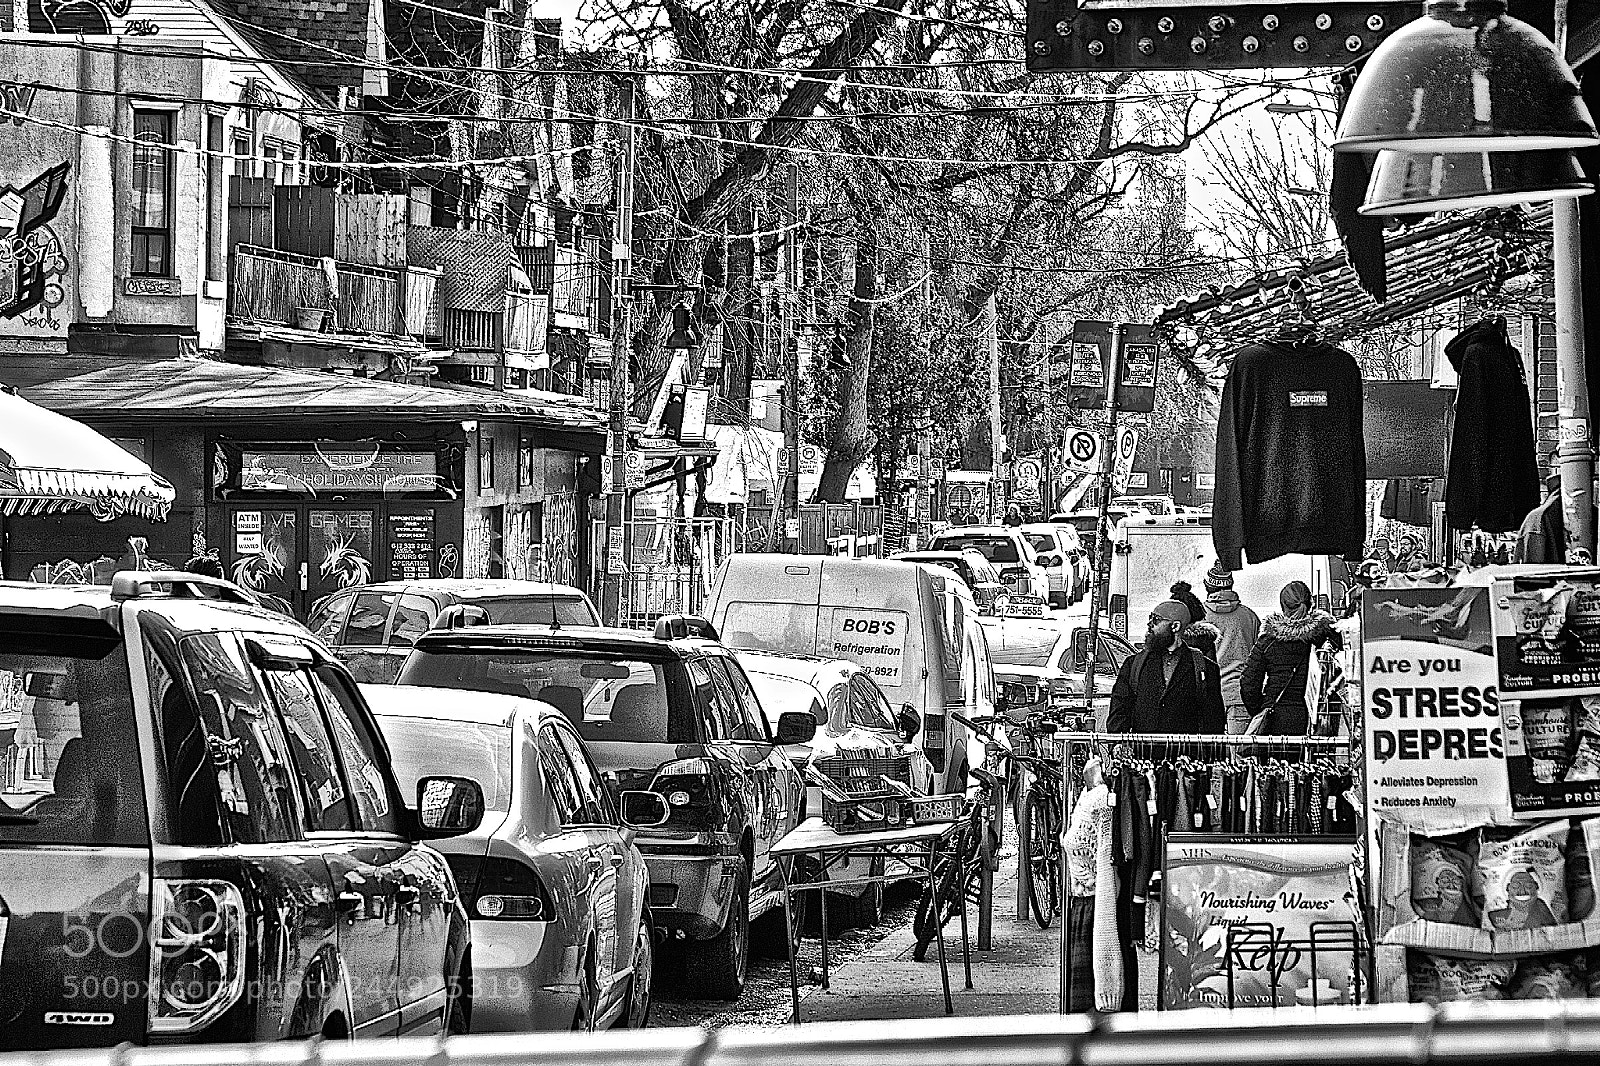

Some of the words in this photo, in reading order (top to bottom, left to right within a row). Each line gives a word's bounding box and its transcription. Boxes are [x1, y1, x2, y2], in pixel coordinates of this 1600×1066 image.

[1289, 393, 1327, 406] Supreme
[238, 514, 259, 522] ATM
[271, 514, 295, 528] VR
[310, 514, 372, 528] GAMES
[1005, 605, 1043, 616] 751-5555
[842, 618, 896, 635] BOB'S
[833, 642, 901, 656] Refrigeration
[1370, 656, 1411, 674] Are
[1418, 658, 1461, 676] you
[1552, 673, 1600, 684] PROBI
[1371, 686, 1500, 719] STRESS
[1524, 725, 1570, 736] ULTURE
[1373, 728, 1504, 761] DEPRES
[1381, 776, 1425, 788] Alleviates
[1426, 775, 1478, 788] Depression
[1381, 796, 1421, 807] Reduces
[1423, 795, 1457, 808] Anxiety
[1181, 848, 1212, 858] MHS
[1200, 891, 1277, 913] Nourishing
[1209, 915, 1249, 929] Liquid
[1215, 926, 1302, 988] Kelp
[49, 1014, 110, 1023] 4WD
